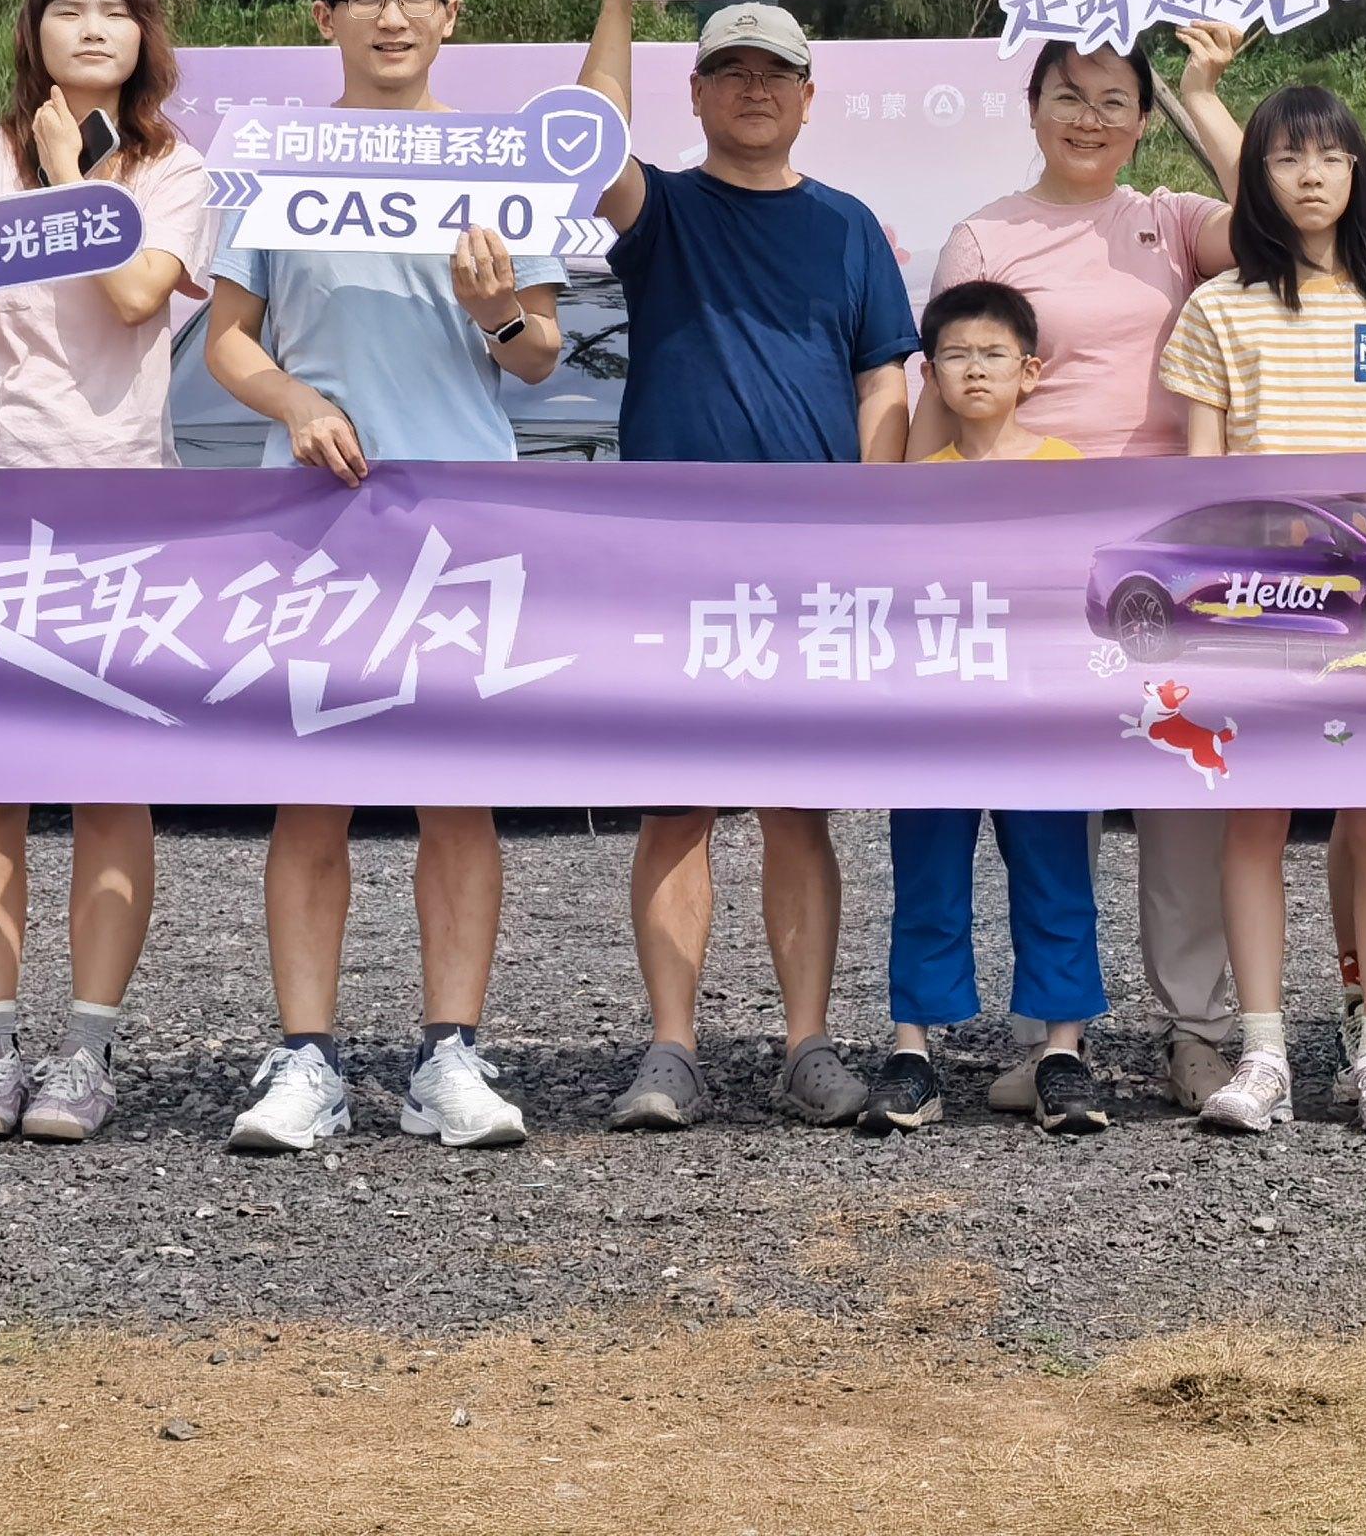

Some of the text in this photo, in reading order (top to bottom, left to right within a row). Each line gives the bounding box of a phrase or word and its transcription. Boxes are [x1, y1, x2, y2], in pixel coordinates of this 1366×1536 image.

[844, 91, 907, 120] 鸿蒙
[233, 118, 527, 168] 全向防碰撞系统
[286, 189, 533, 240] CAS 40
[1225, 570, 1333, 611] Hello!
